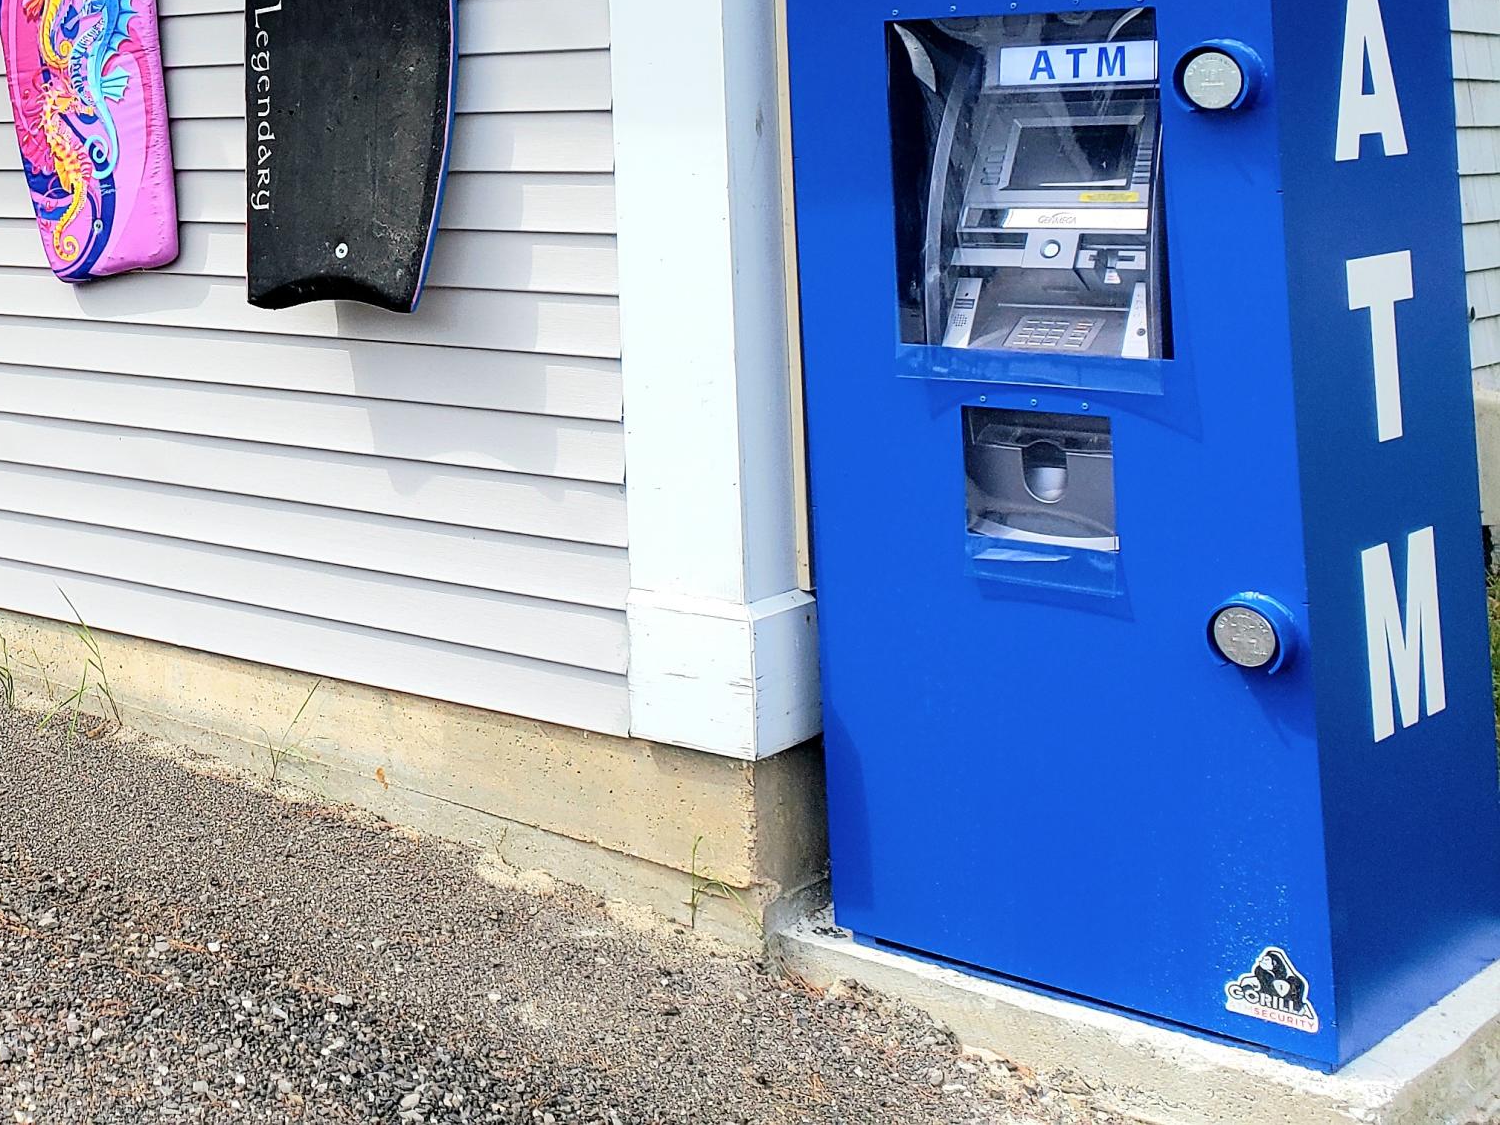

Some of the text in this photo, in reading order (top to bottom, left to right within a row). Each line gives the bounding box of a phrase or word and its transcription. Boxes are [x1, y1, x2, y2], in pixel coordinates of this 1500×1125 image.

[1029, 45, 1126, 81] ATM
[1227, 983, 1315, 1020] GORILLA
[1253, 1006, 1315, 1030] SECURITY
